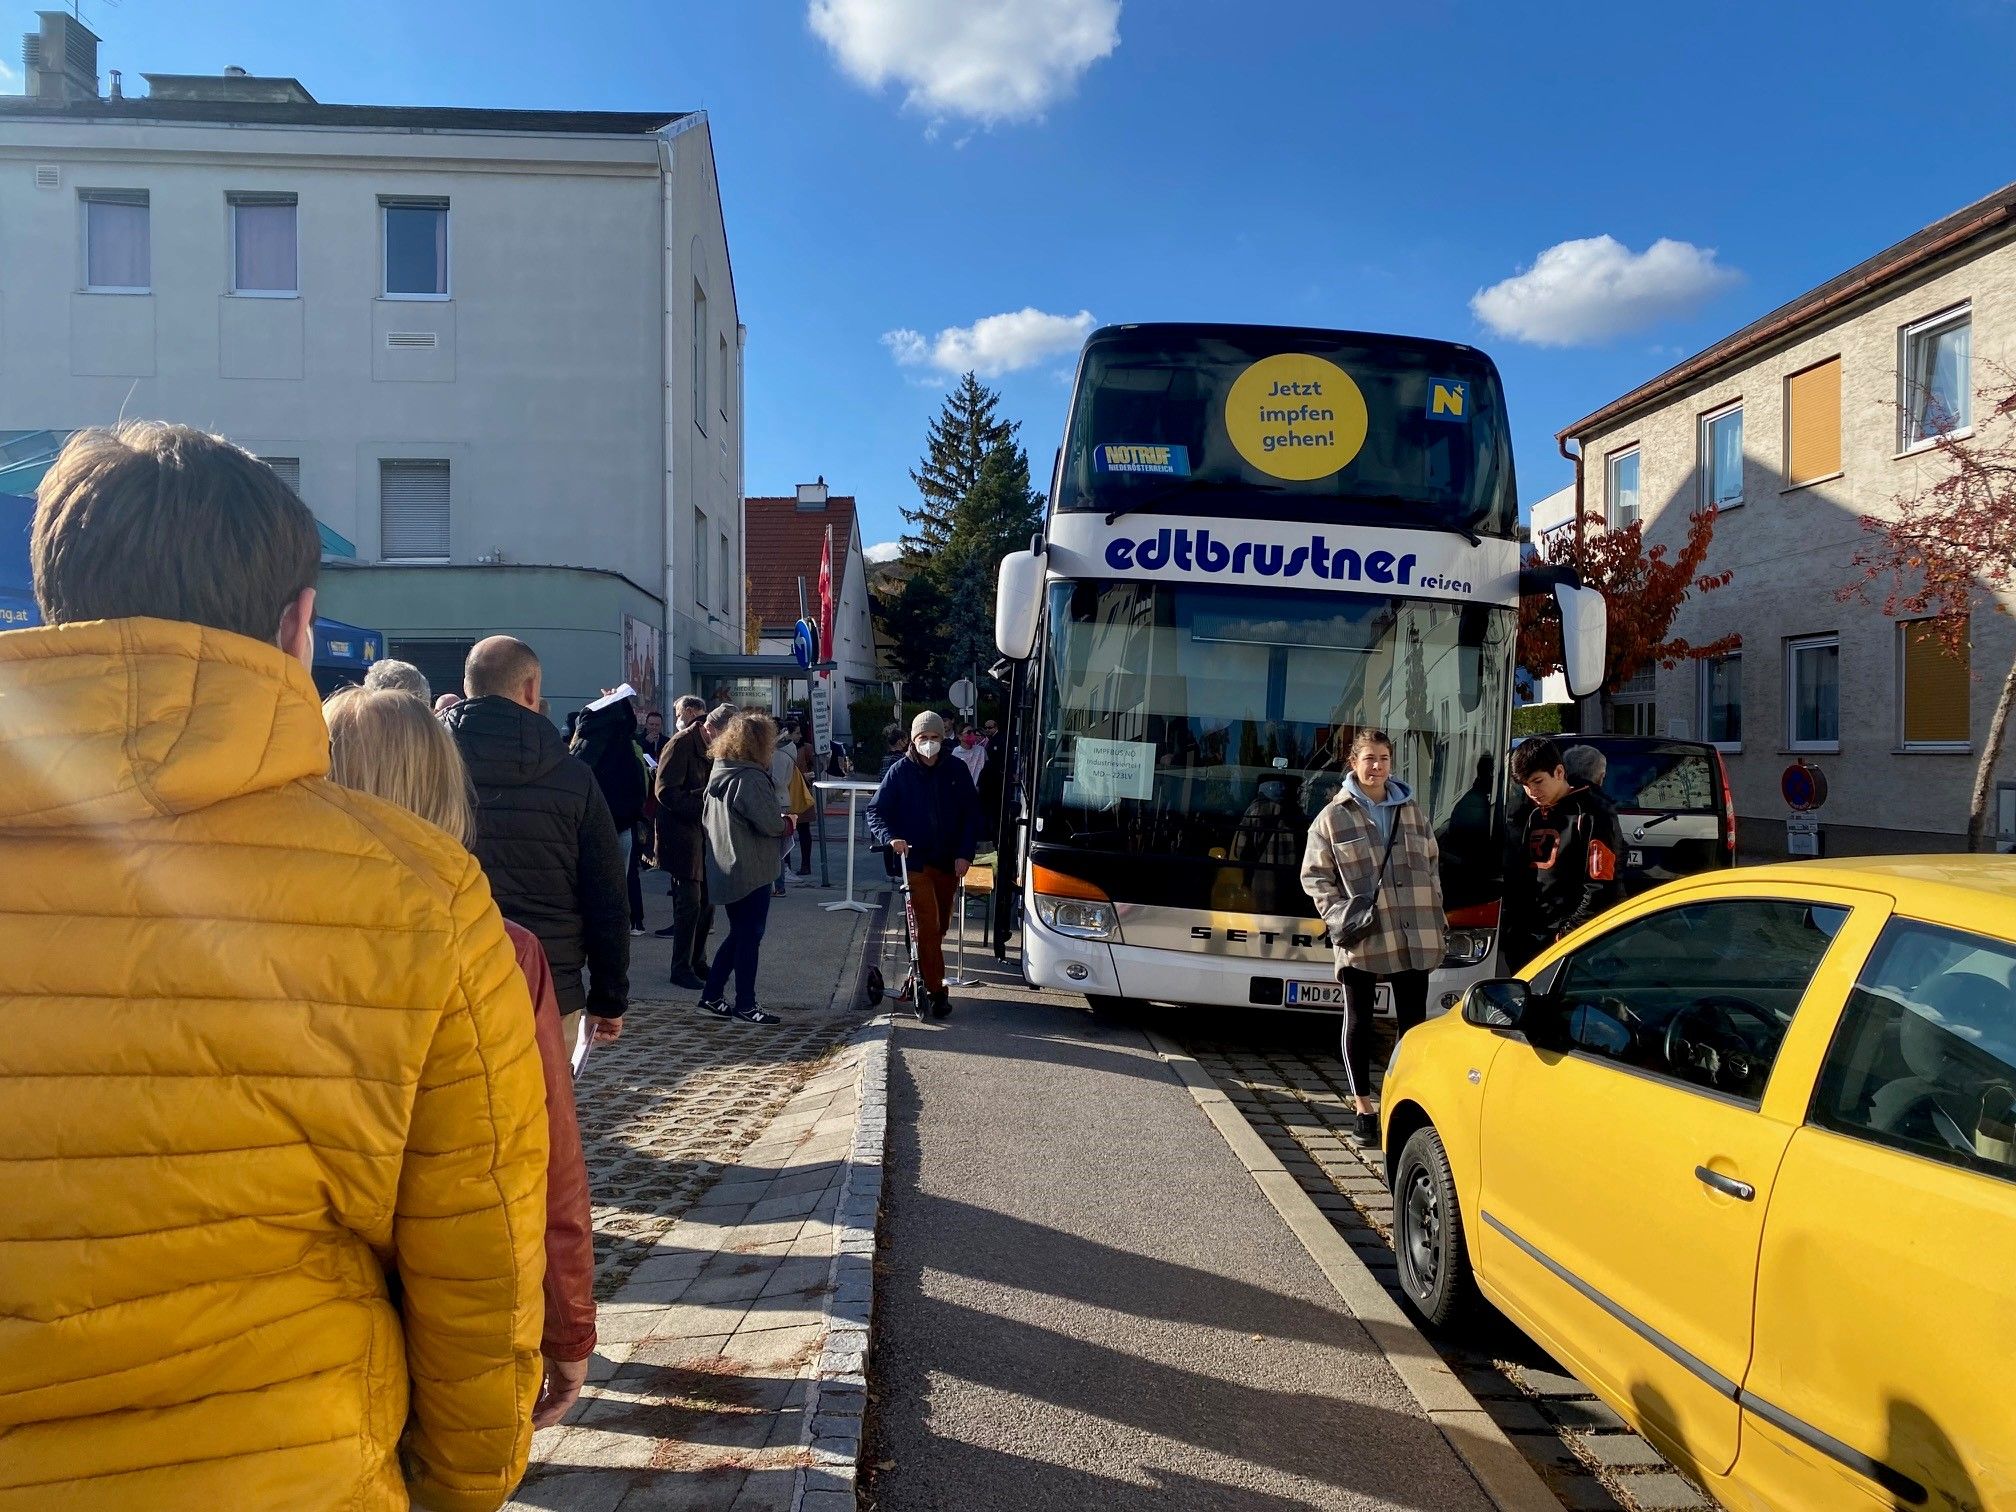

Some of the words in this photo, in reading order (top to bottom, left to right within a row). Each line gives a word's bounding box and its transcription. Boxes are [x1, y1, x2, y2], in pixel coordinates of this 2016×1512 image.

[1268, 381, 1322, 397] Jetzt
[1259, 406, 1335, 427] impfen
[1262, 431, 1336, 453] gehen!
[1105, 445, 1171, 465] NOTRUF
[1108, 463, 1174, 473] NIEDERÖSTERREICH
[1104, 528, 1416, 585] edtbrustner
[1420, 574, 1472, 594] reisen
